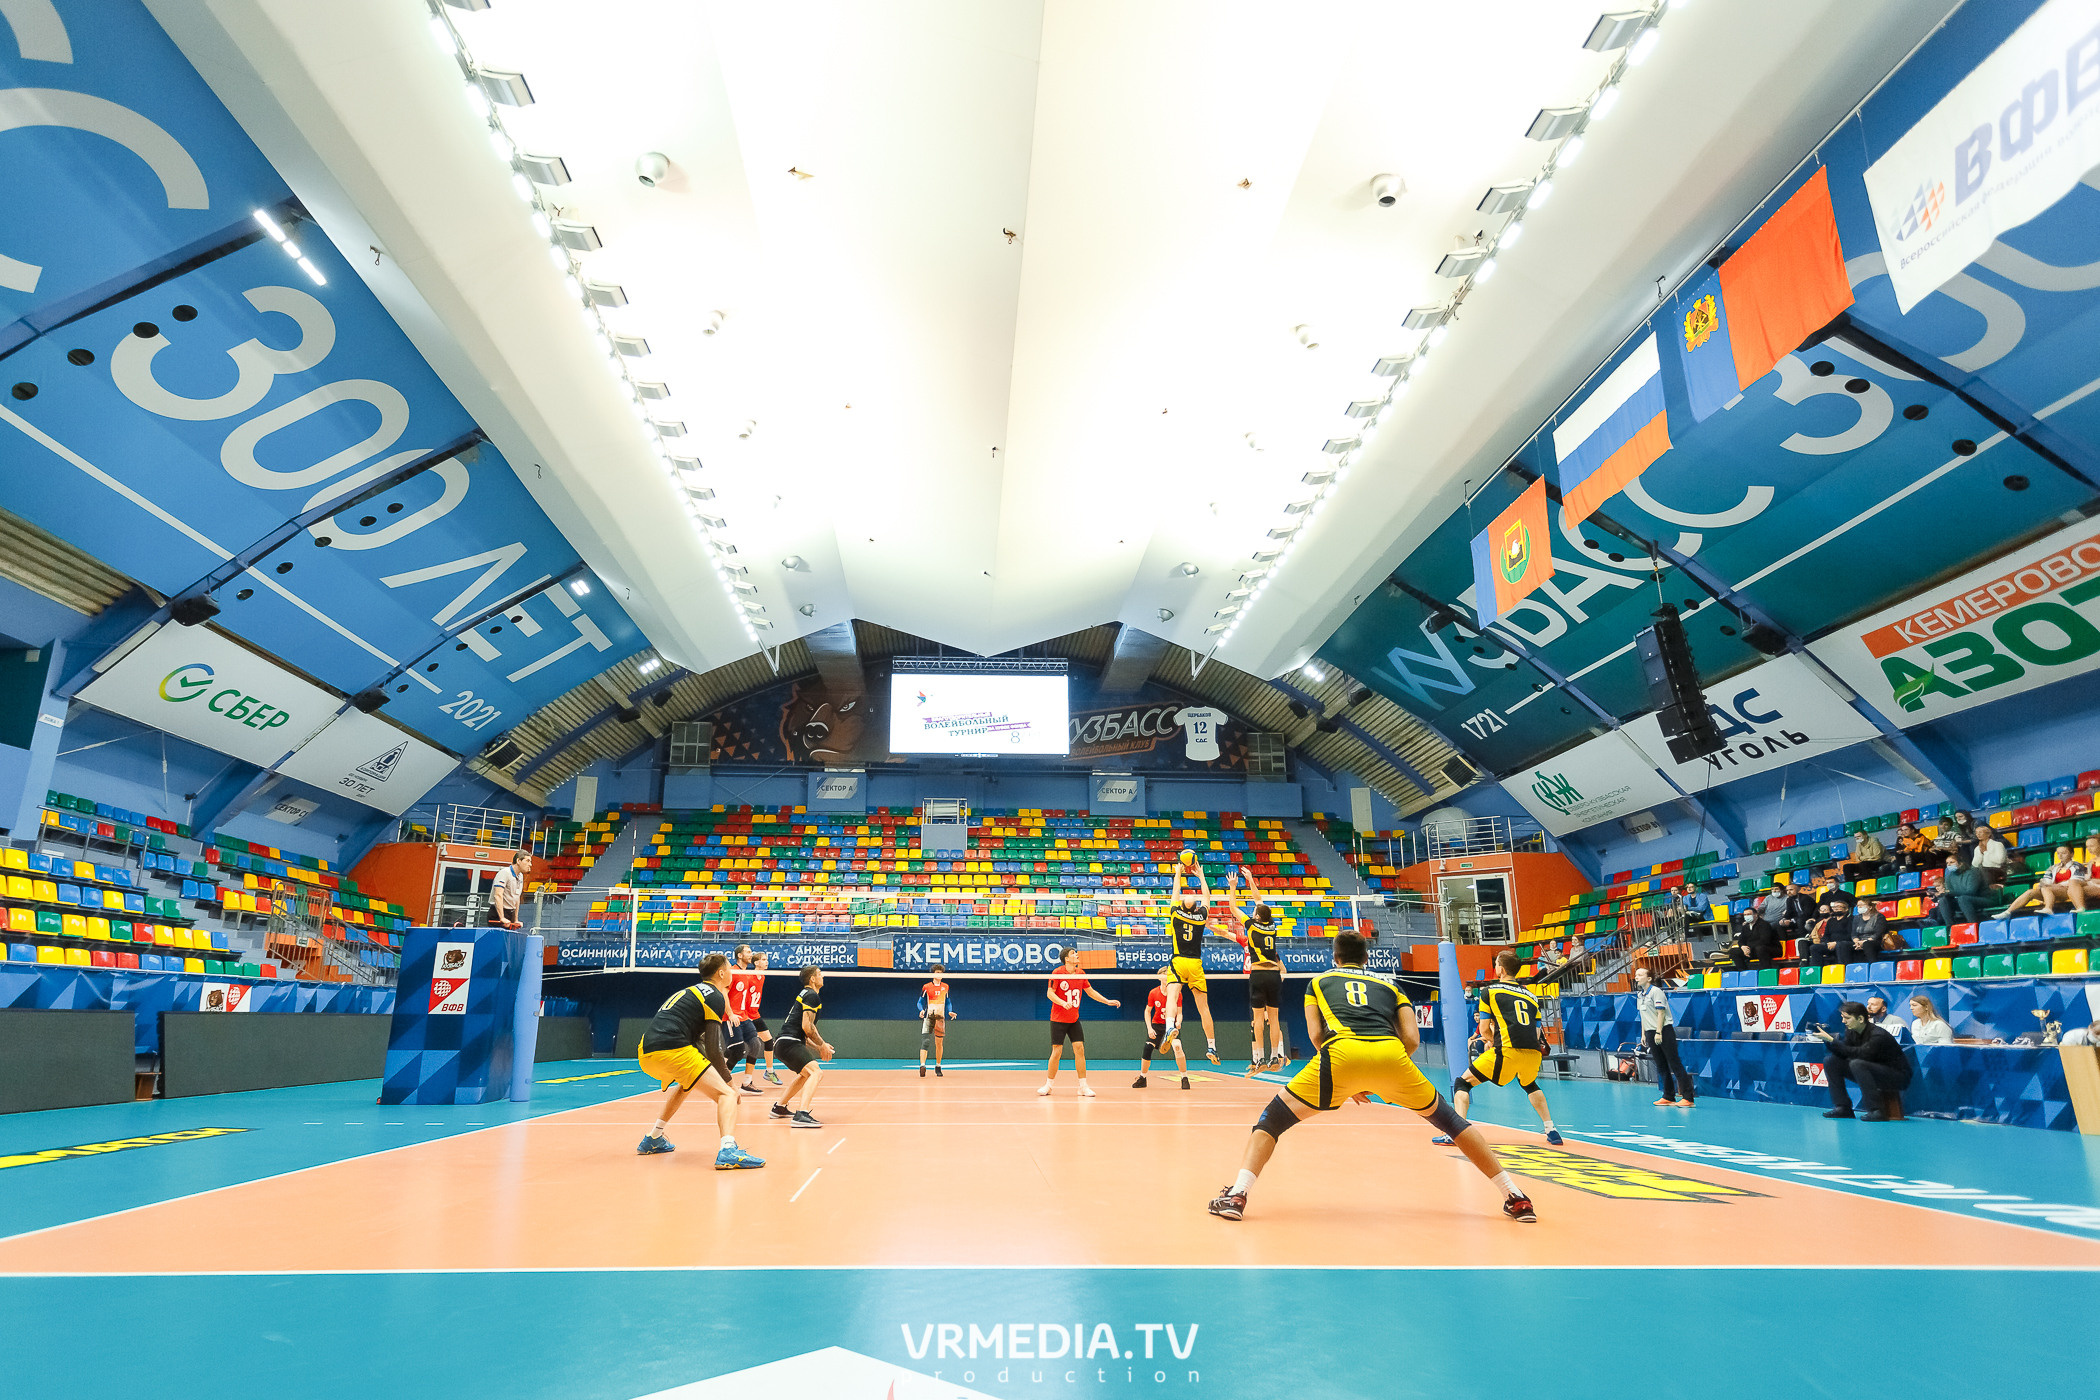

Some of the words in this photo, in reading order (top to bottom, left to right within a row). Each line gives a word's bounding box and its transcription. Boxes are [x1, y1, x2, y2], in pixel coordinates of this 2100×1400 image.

[110, 285, 470, 551] 300
[379, 540, 613, 684] ЛЕТ
[1893, 542, 2100, 645] КЕМЕРОВО
[208, 688, 290, 732] СБЕР
[438, 690, 503, 733] 2021
[924, 714, 1009, 730] ВОЛЕЙБОЛЬНЫЙ
[1069, 706, 1178, 745] УЗБАСС
[1193, 721, 1208, 734] 12
[1460, 708, 1509, 741] 1721
[948, 727, 988, 737] ТУРНИР
[1701, 729, 1810, 771] УГОЛЬ
[338, 777, 356, 788] 30
[353, 783, 376, 795] ЛЕТ
[274, 803, 302, 815] СЕКТОР
[1183, 923, 1194, 941] 3
[794, 944, 847, 955] АНЖЕРО
[1264, 935, 1274, 950] 9
[561, 948, 628, 959] ОСИННИКИ
[635, 946, 673, 959] ТАЙГА
[787, 955, 855, 966] СУДЖЕНСК
[905, 942, 1063, 964] КЕМЕРОВО
[1285, 954, 1325, 963] ТОПКИ
[750, 991, 761, 1008] 12
[1064, 988, 1081, 1008] 13
[1344, 981, 1369, 1007] 8
[441, 1003, 465, 1012] ВФВ
[1514, 999, 1530, 1026] 6
[1775, 1021, 1791, 1030] ВФВ
